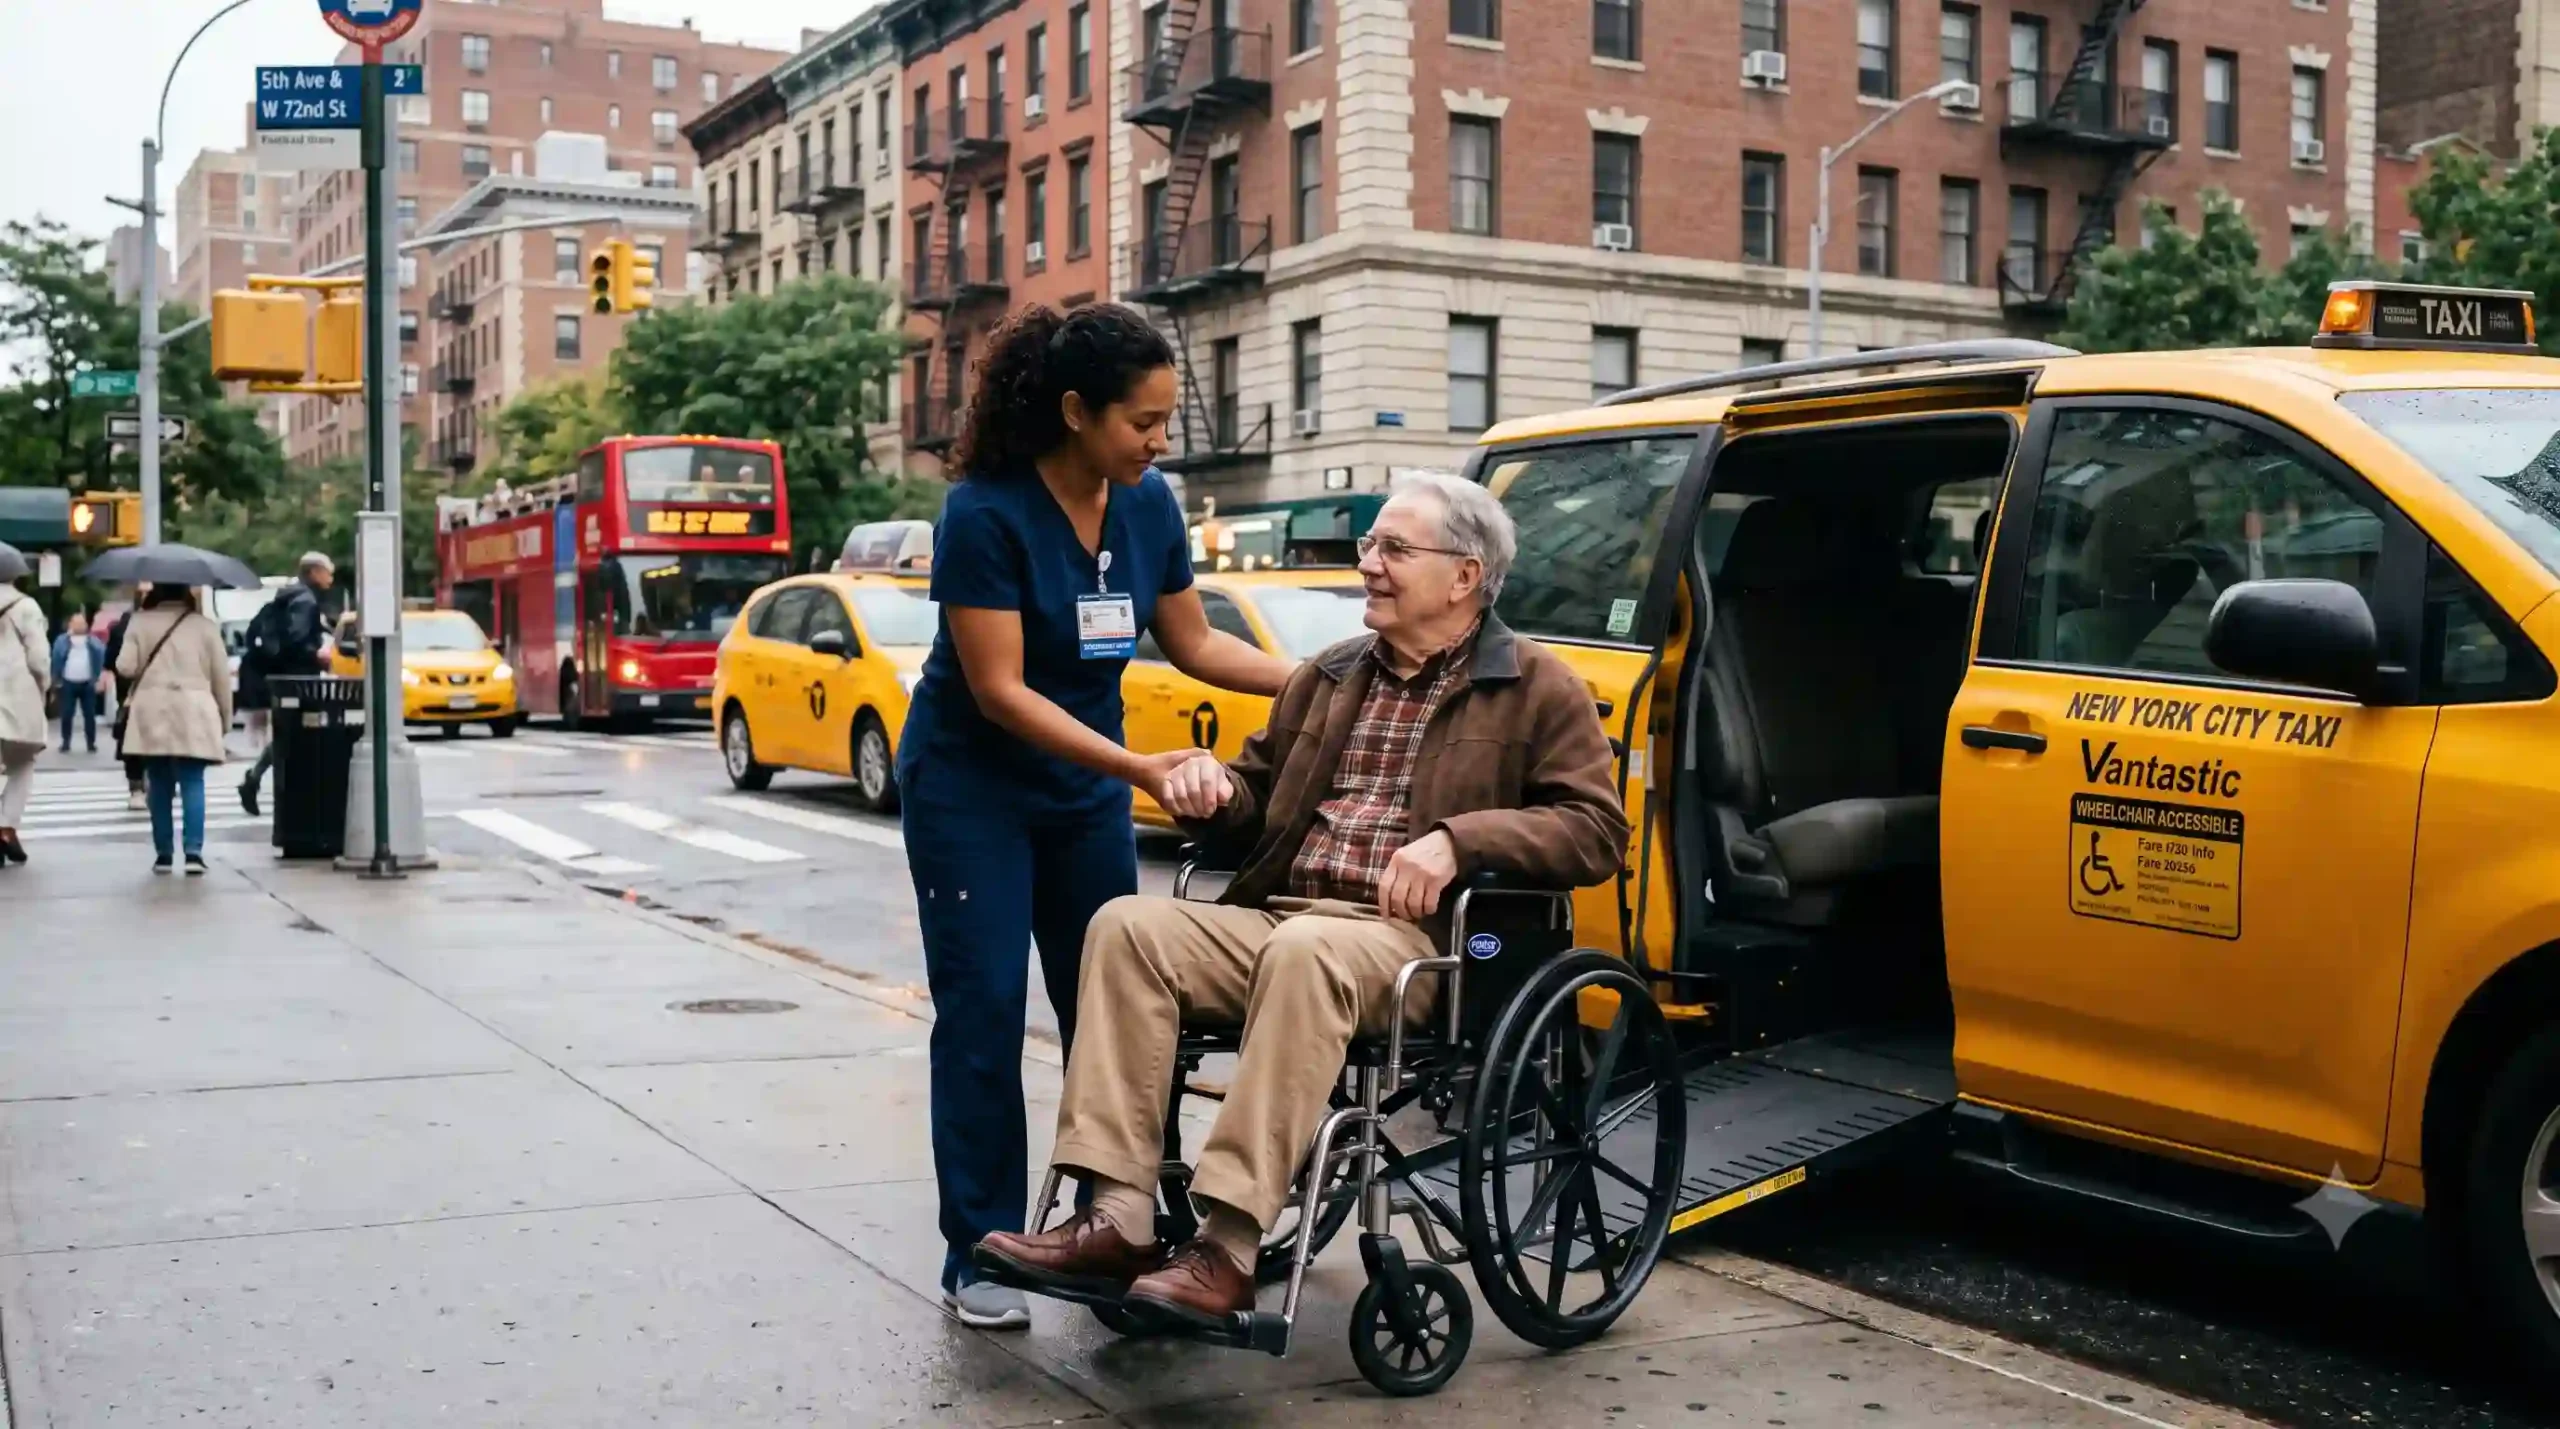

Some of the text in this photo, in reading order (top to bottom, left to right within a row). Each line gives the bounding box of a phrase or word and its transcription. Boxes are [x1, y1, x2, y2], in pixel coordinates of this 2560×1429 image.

[261, 69, 343, 90] 5th Ave &
[262, 99, 347, 119] W 72nd St
[2420, 299, 2482, 336] TAXI
[2065, 692, 2342, 748] NEW YORK CITY TAXI
[2080, 738, 2242, 798] Vantastic
[2076, 800, 2240, 836] WHEELCHAIR ACCESSIBLE
[2137, 855, 2161, 870] Fare
[2138, 837, 2163, 853] Fare
[2192, 844, 2215, 860] Info
